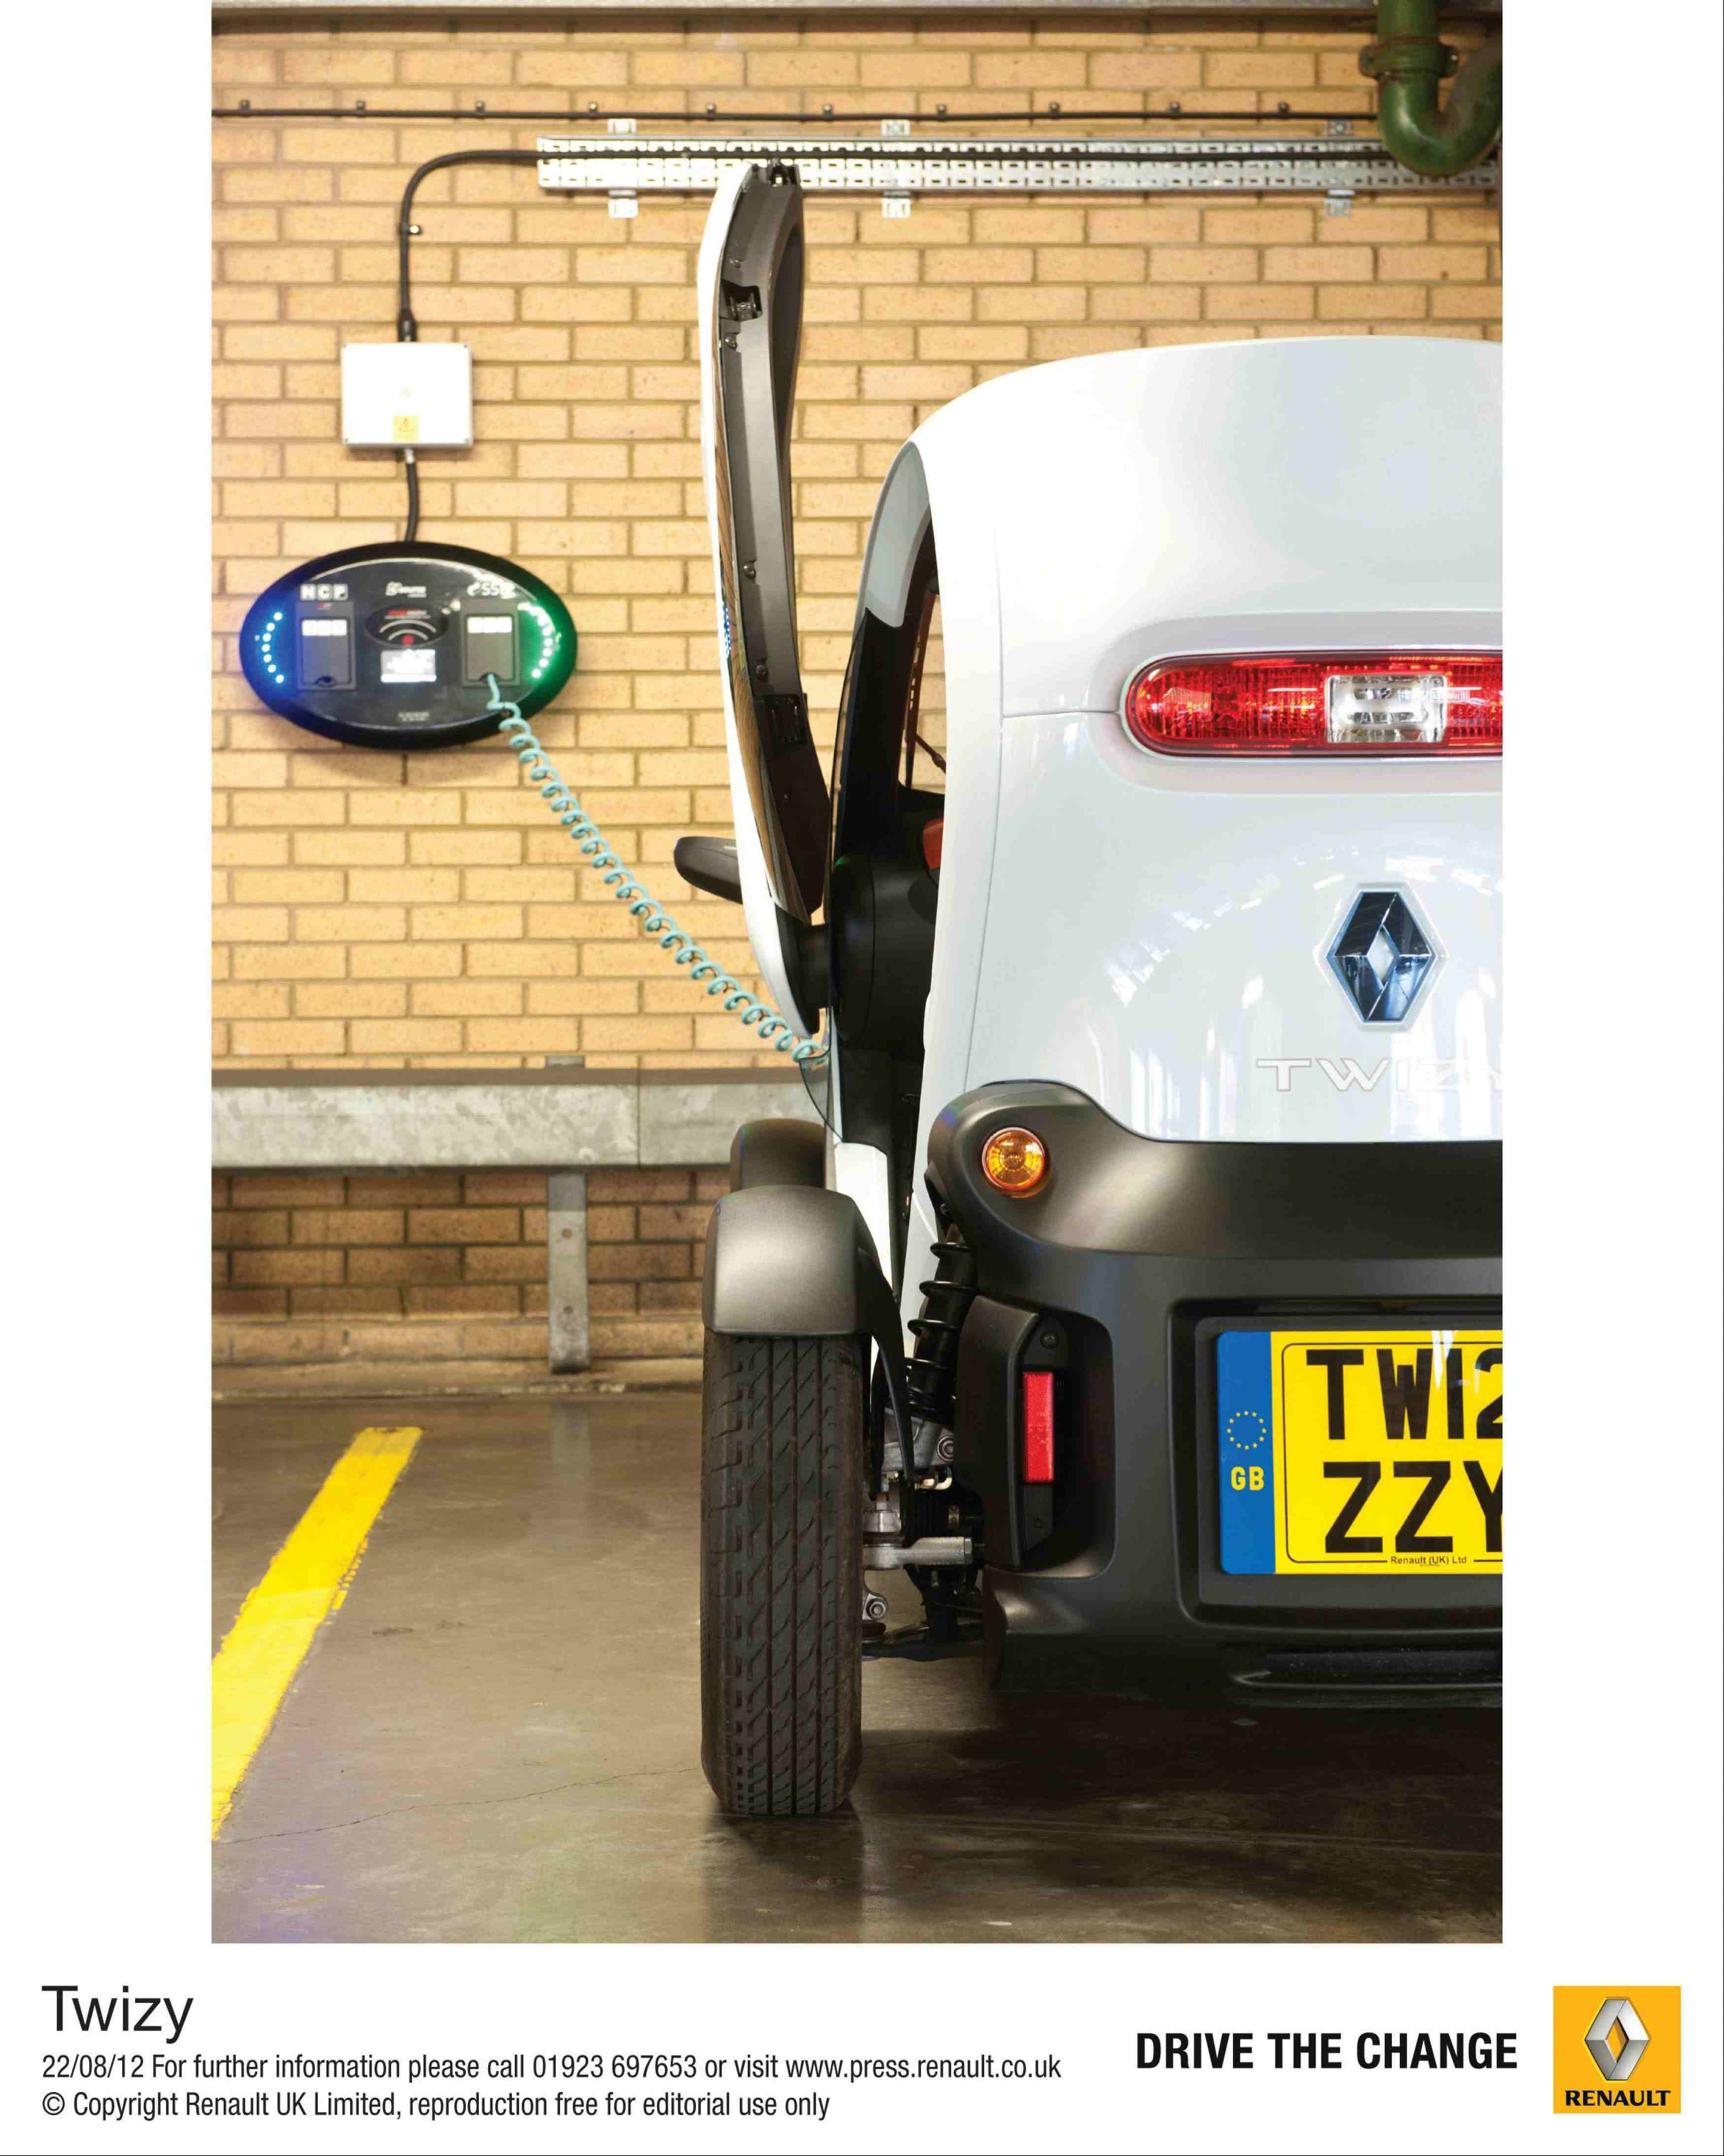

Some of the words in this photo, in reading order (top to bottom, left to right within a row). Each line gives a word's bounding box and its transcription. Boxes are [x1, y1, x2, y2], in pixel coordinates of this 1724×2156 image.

[1231, 1466, 1264, 1491] GB
[1323, 1461, 1503, 1553] ZZY
[1391, 1556, 1426, 1565] Renault
[1428, 1556, 1450, 1566] (UK)
[1452, 1556, 1467, 1564] Ltd
